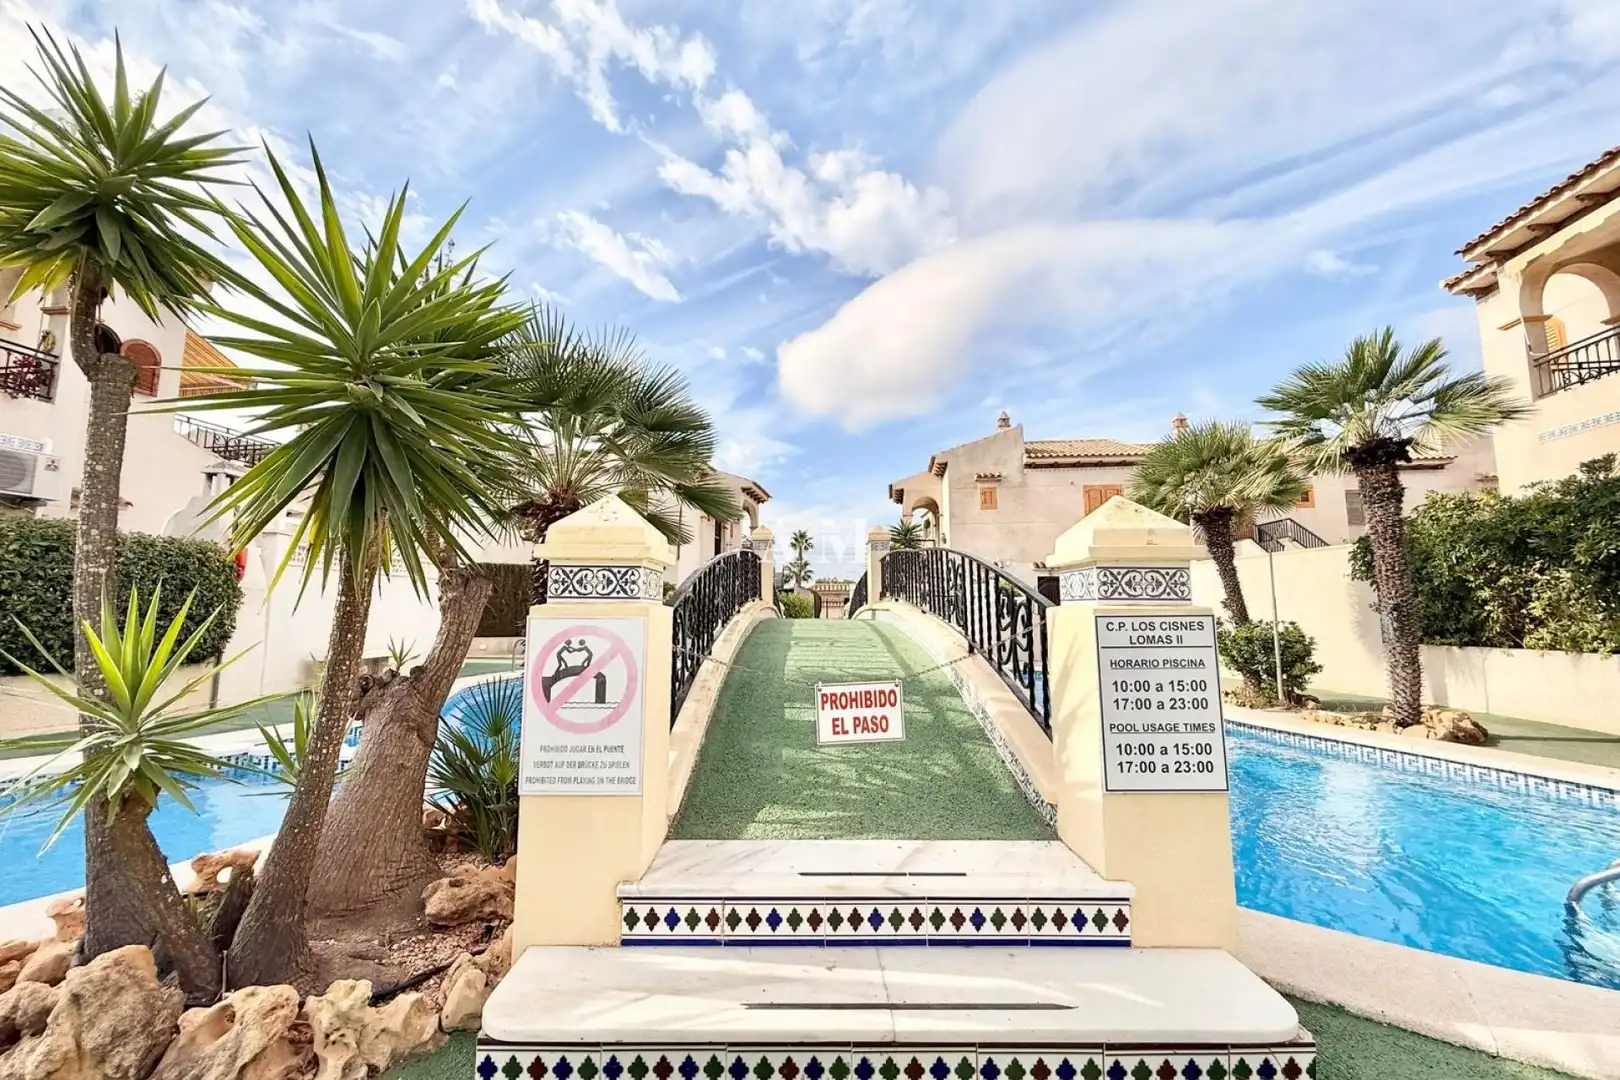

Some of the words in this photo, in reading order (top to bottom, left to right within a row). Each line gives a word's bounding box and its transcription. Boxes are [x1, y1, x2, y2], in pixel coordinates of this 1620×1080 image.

[1106, 621, 1128, 631] C.P.
[1131, 621, 1156, 631] LOS
[1159, 621, 1205, 631] CISNES
[1129, 635, 1173, 645] LOMAS
[1176, 635, 1183, 645] II
[1110, 659, 1160, 669] HORARIO
[1162, 658, 1206, 668] PISCINA
[1112, 680, 1150, 692] 10:00
[1155, 682, 1164, 692] a
[1168, 680, 1207, 692] 15:00
[820, 689, 897, 710] PROHIBIDO
[1113, 698, 1151, 710] 17:00
[1156, 700, 1165, 710] a
[1169, 698, 1208, 710] 23:00
[832, 717, 849, 735] EL
[853, 714, 889, 734] PASO
[1109, 723, 1140, 732] POOL
[1142, 723, 1180, 732] USAGE
[1183, 723, 1216, 732] TIMES
[539, 744, 568, 754] PROHIBIDO
[569, 744, 587, 754] JUGAR
[587, 744, 595, 753] EN
[595, 744, 602, 753] EL
[603, 744, 624, 753] PUENTE
[1116, 743, 1155, 755] 10:00
[1159, 746, 1168, 755] a
[1173, 743, 1213, 755] 15:00
[532, 760, 554, 769] VERBOT
[554, 760, 565, 769] AUF
[566, 760, 577, 769] DER
[577, 759, 598, 769] BRÜCKE
[599, 760, 607, 769] ZU
[608, 760, 630, 769] SPIELEN
[1117, 761, 1156, 773] 17:00
[1161, 764, 1170, 773] a
[1174, 761, 1214, 773] 23:00
[525, 776, 556, 785] PROHIBITED
[557, 776, 572, 785] FROM
[596, 776, 604, 785] ON
[605, 776, 616, 785] THE
[617, 776, 637, 785] BRIDGE
